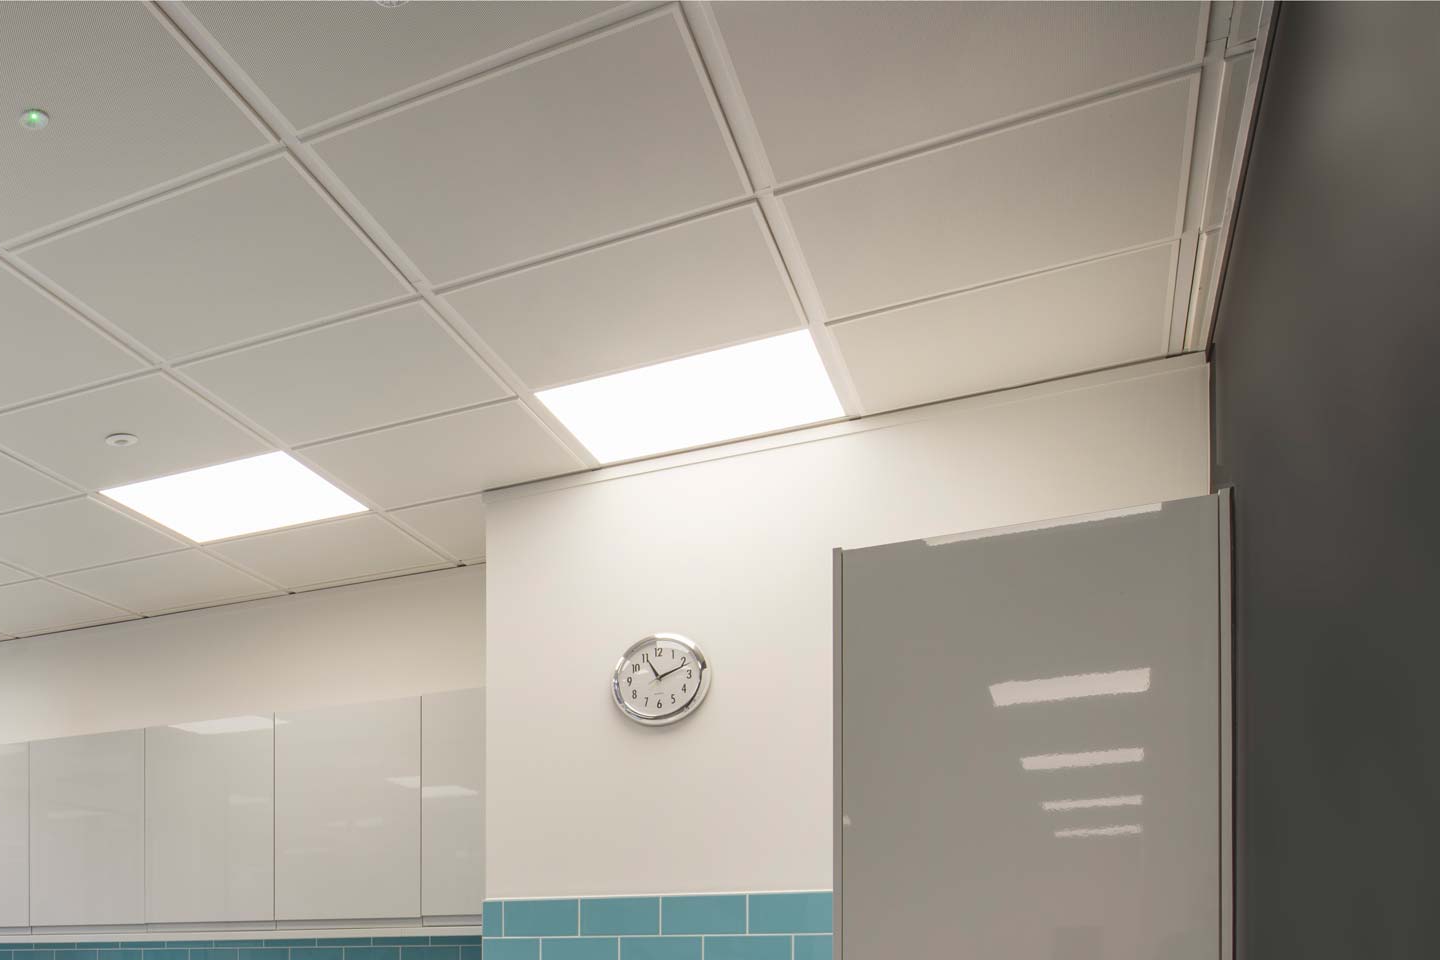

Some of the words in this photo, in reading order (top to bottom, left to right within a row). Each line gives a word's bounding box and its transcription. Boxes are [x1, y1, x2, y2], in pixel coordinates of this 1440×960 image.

[654, 648, 663, 657] 12
[641, 653, 650, 663] 11
[680, 656, 687, 667] 2
[632, 664, 641, 674] 10
[686, 670, 692, 679] 3
[627, 677, 632, 687] 9
[681, 683, 687, 693] 4
[632, 689, 637, 699] 8
[671, 694, 676, 704] 5
[645, 697, 649, 707] 7
[657, 700, 662, 709] 6
